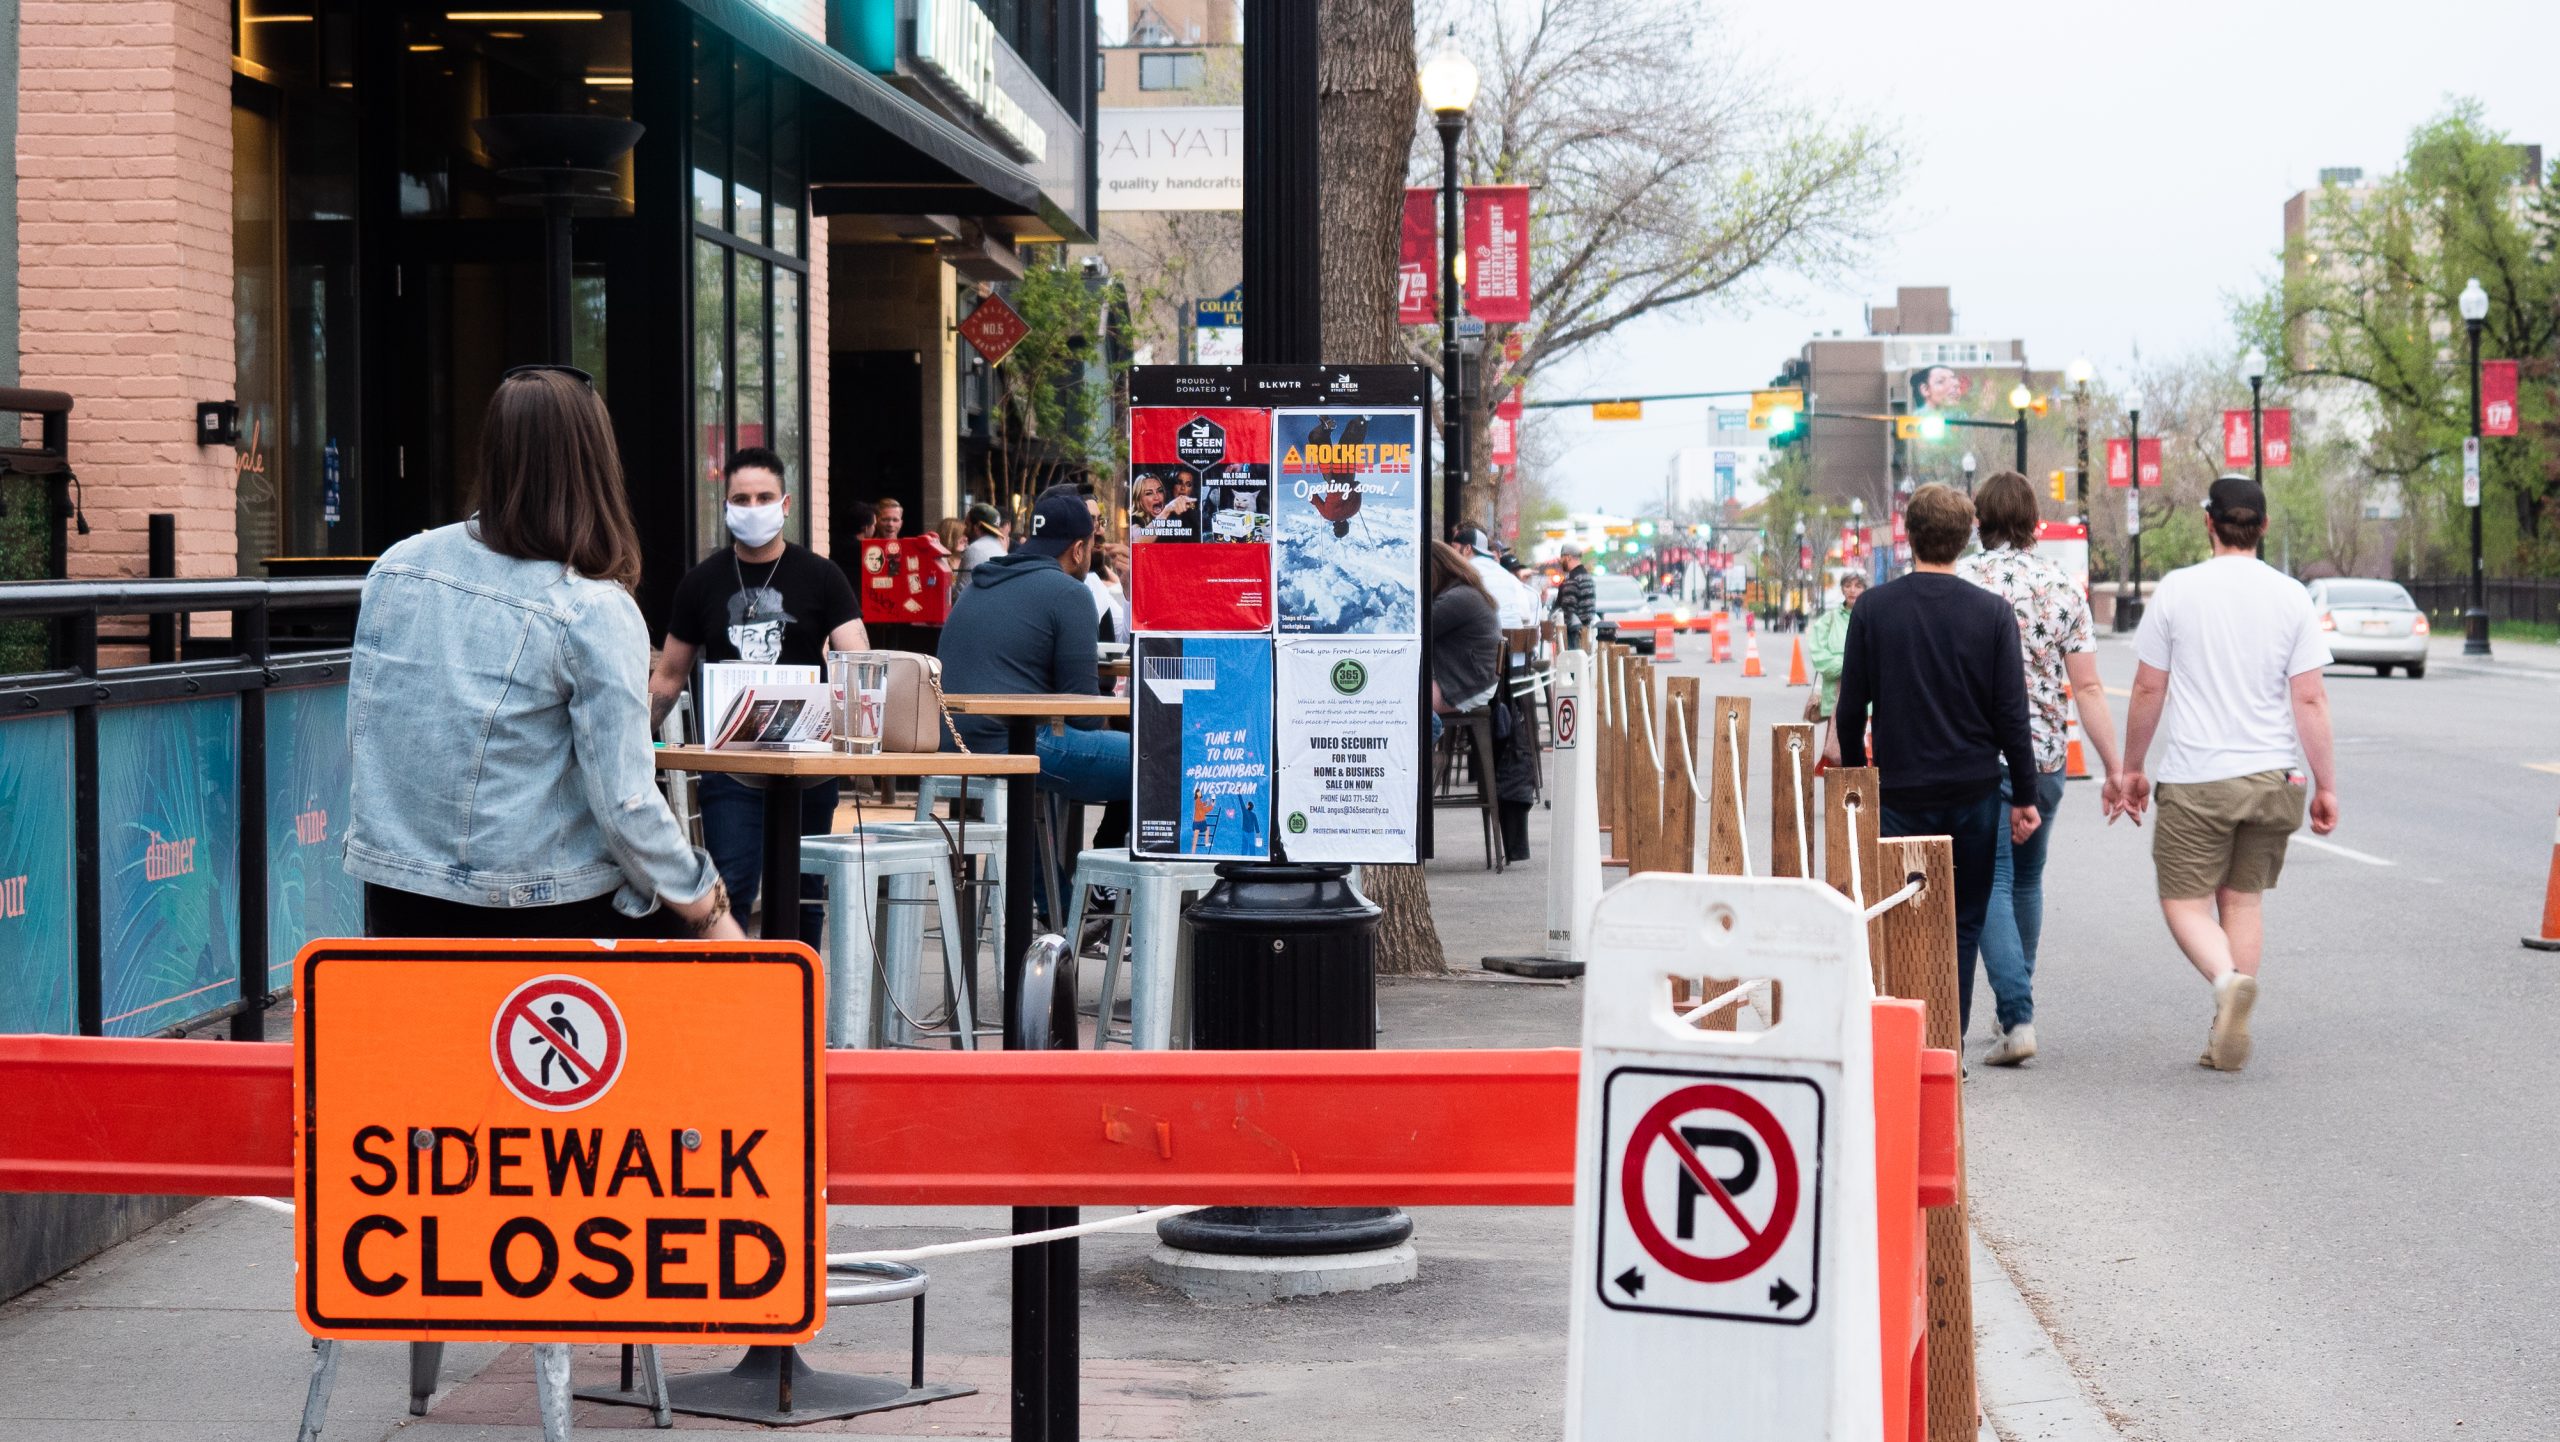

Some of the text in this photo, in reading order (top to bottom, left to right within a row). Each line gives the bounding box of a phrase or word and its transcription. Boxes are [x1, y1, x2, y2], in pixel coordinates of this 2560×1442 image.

[1098, 127, 1241, 159] AIYAT
[1109, 177, 1159, 193] quality
[1166, 175, 1242, 190] handcrafts
[1491, 205, 1505, 296] ENTERTAINMENT
[1478, 259, 1491, 296] RETAIL
[1504, 246, 1518, 296] DISTRICT
[1225, 314, 1242, 324] PL
[982, 323, 1004, 335] NO.5
[1259, 381, 1301, 389] BLKWTR
[1180, 439, 1222, 447] BE SEEN
[1305, 444, 1410, 464] ROCKET PIE
[1294, 480, 1352, 500] Opening
[1032, 514, 1045, 536] P
[1141, 528, 1154, 536] YOU
[1155, 528, 1173, 536] WERE
[1340, 670, 1358, 680] 365
[1205, 729, 1246, 746] TUNE IN
[1310, 737, 1388, 749] VIDEO SECURITY
[1208, 748, 1244, 761] TO OUR
[1332, 754, 1366, 763] FOR YOUR
[1186, 763, 1266, 779] #BALCONYBASH
[1314, 767, 1384, 777] HOME & BUSINESS
[1194, 781, 1257, 795] LIVESTREAM
[1326, 780, 1373, 789] SALE ON NOW
[296, 800, 327, 846] wine
[146, 832, 196, 882] dinner
[350, 1124, 770, 1198] SIDEWALK
[342, 1214, 786, 1300] CLOSED
